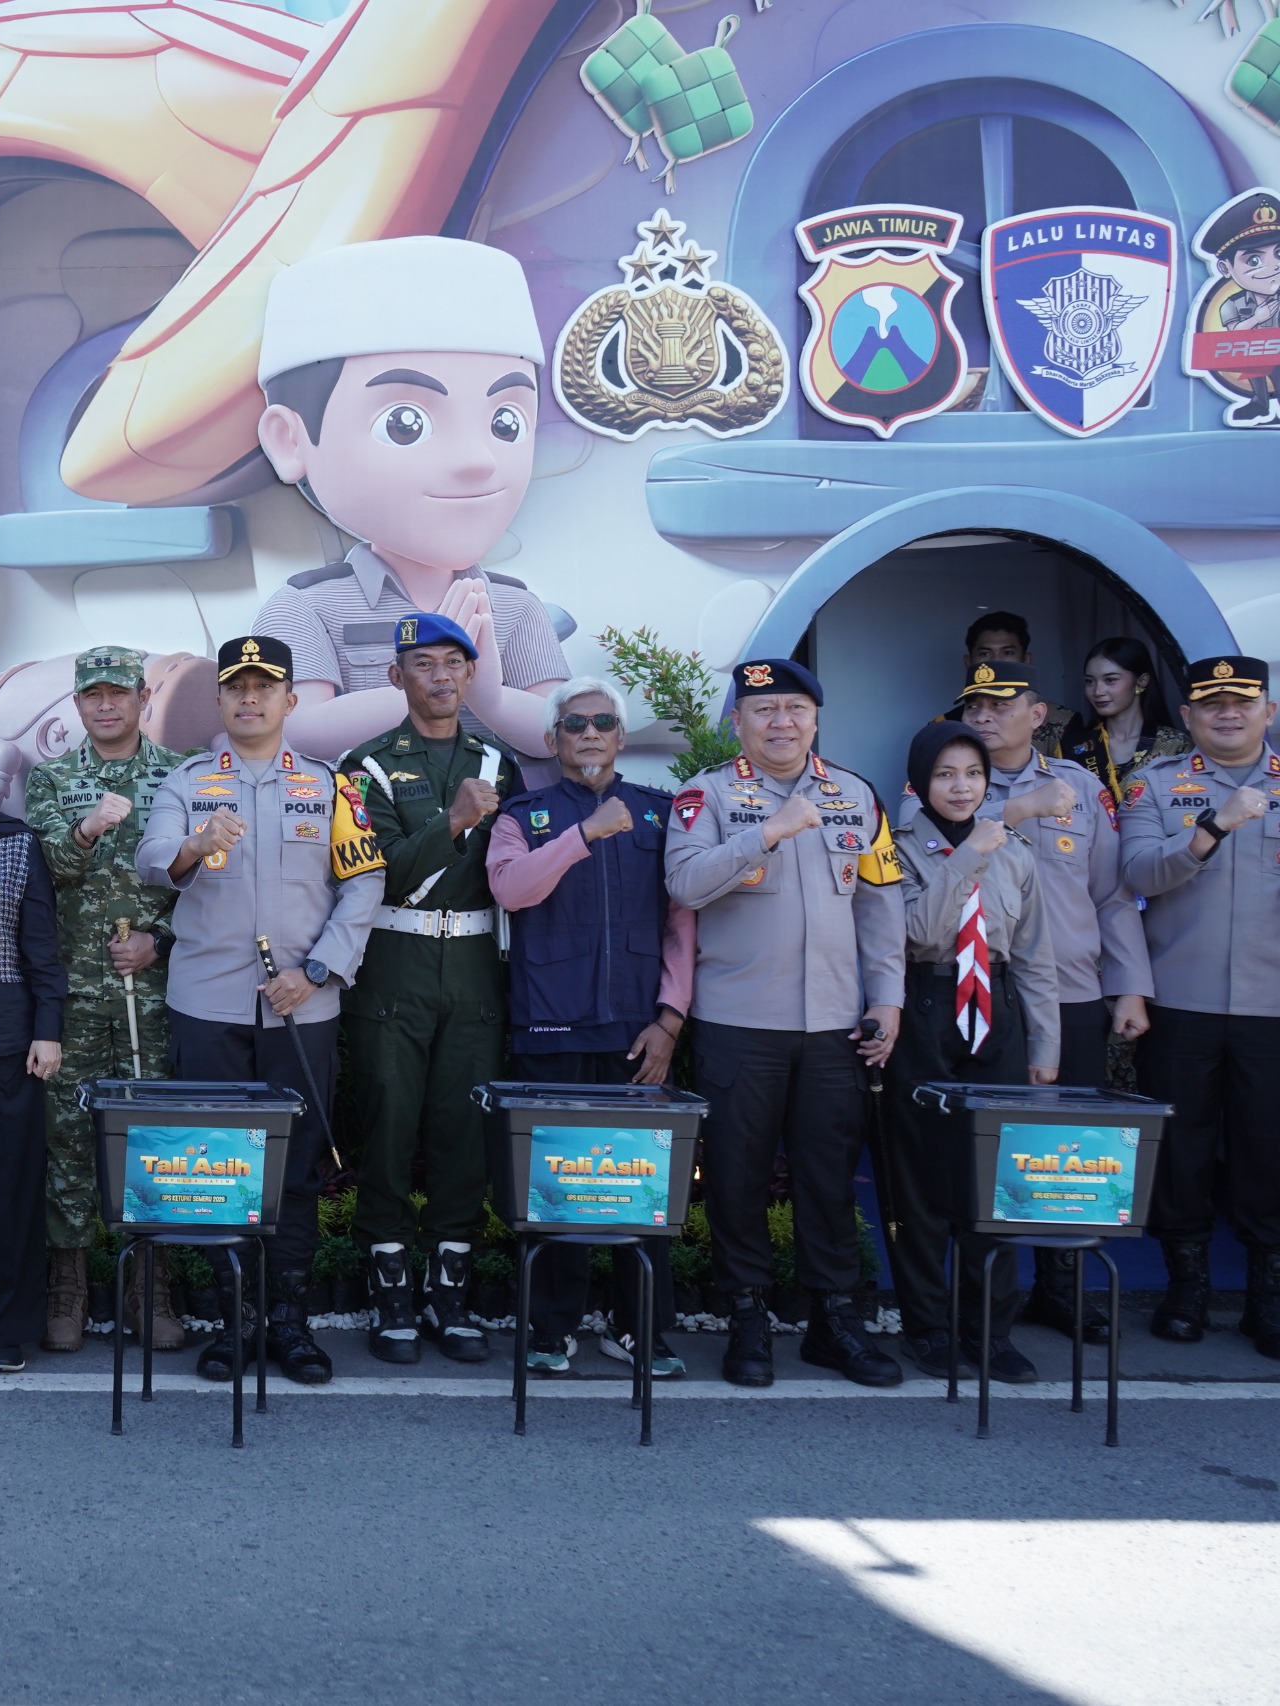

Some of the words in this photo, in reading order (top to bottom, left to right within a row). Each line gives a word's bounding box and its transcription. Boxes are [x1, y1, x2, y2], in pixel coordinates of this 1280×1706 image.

[822, 220, 874, 243] JAWA
[878, 218, 938, 238] TIMUR
[1008, 226, 1064, 252] LALU
[1076, 224, 1156, 250] LINTAS
[1214, 339, 1280, 358] PRES
[1086, 756, 1100, 778] DUT
[62, 793, 92, 805] DHAVID
[394, 784, 430, 797] RDIN
[284, 803, 326, 815] POLRI
[1170, 797, 1210, 807] ARDI
[730, 812, 770, 824] SURY
[822, 815, 863, 827] POLRI
[140, 1156, 187, 1175] Tali
[192, 1158, 250, 1176] Asih
[544, 1156, 593, 1175] Tali
[597, 1158, 656, 1176] Asih
[1011, 1154, 1059, 1172] Tali
[1063, 1156, 1123, 1175] Asih
